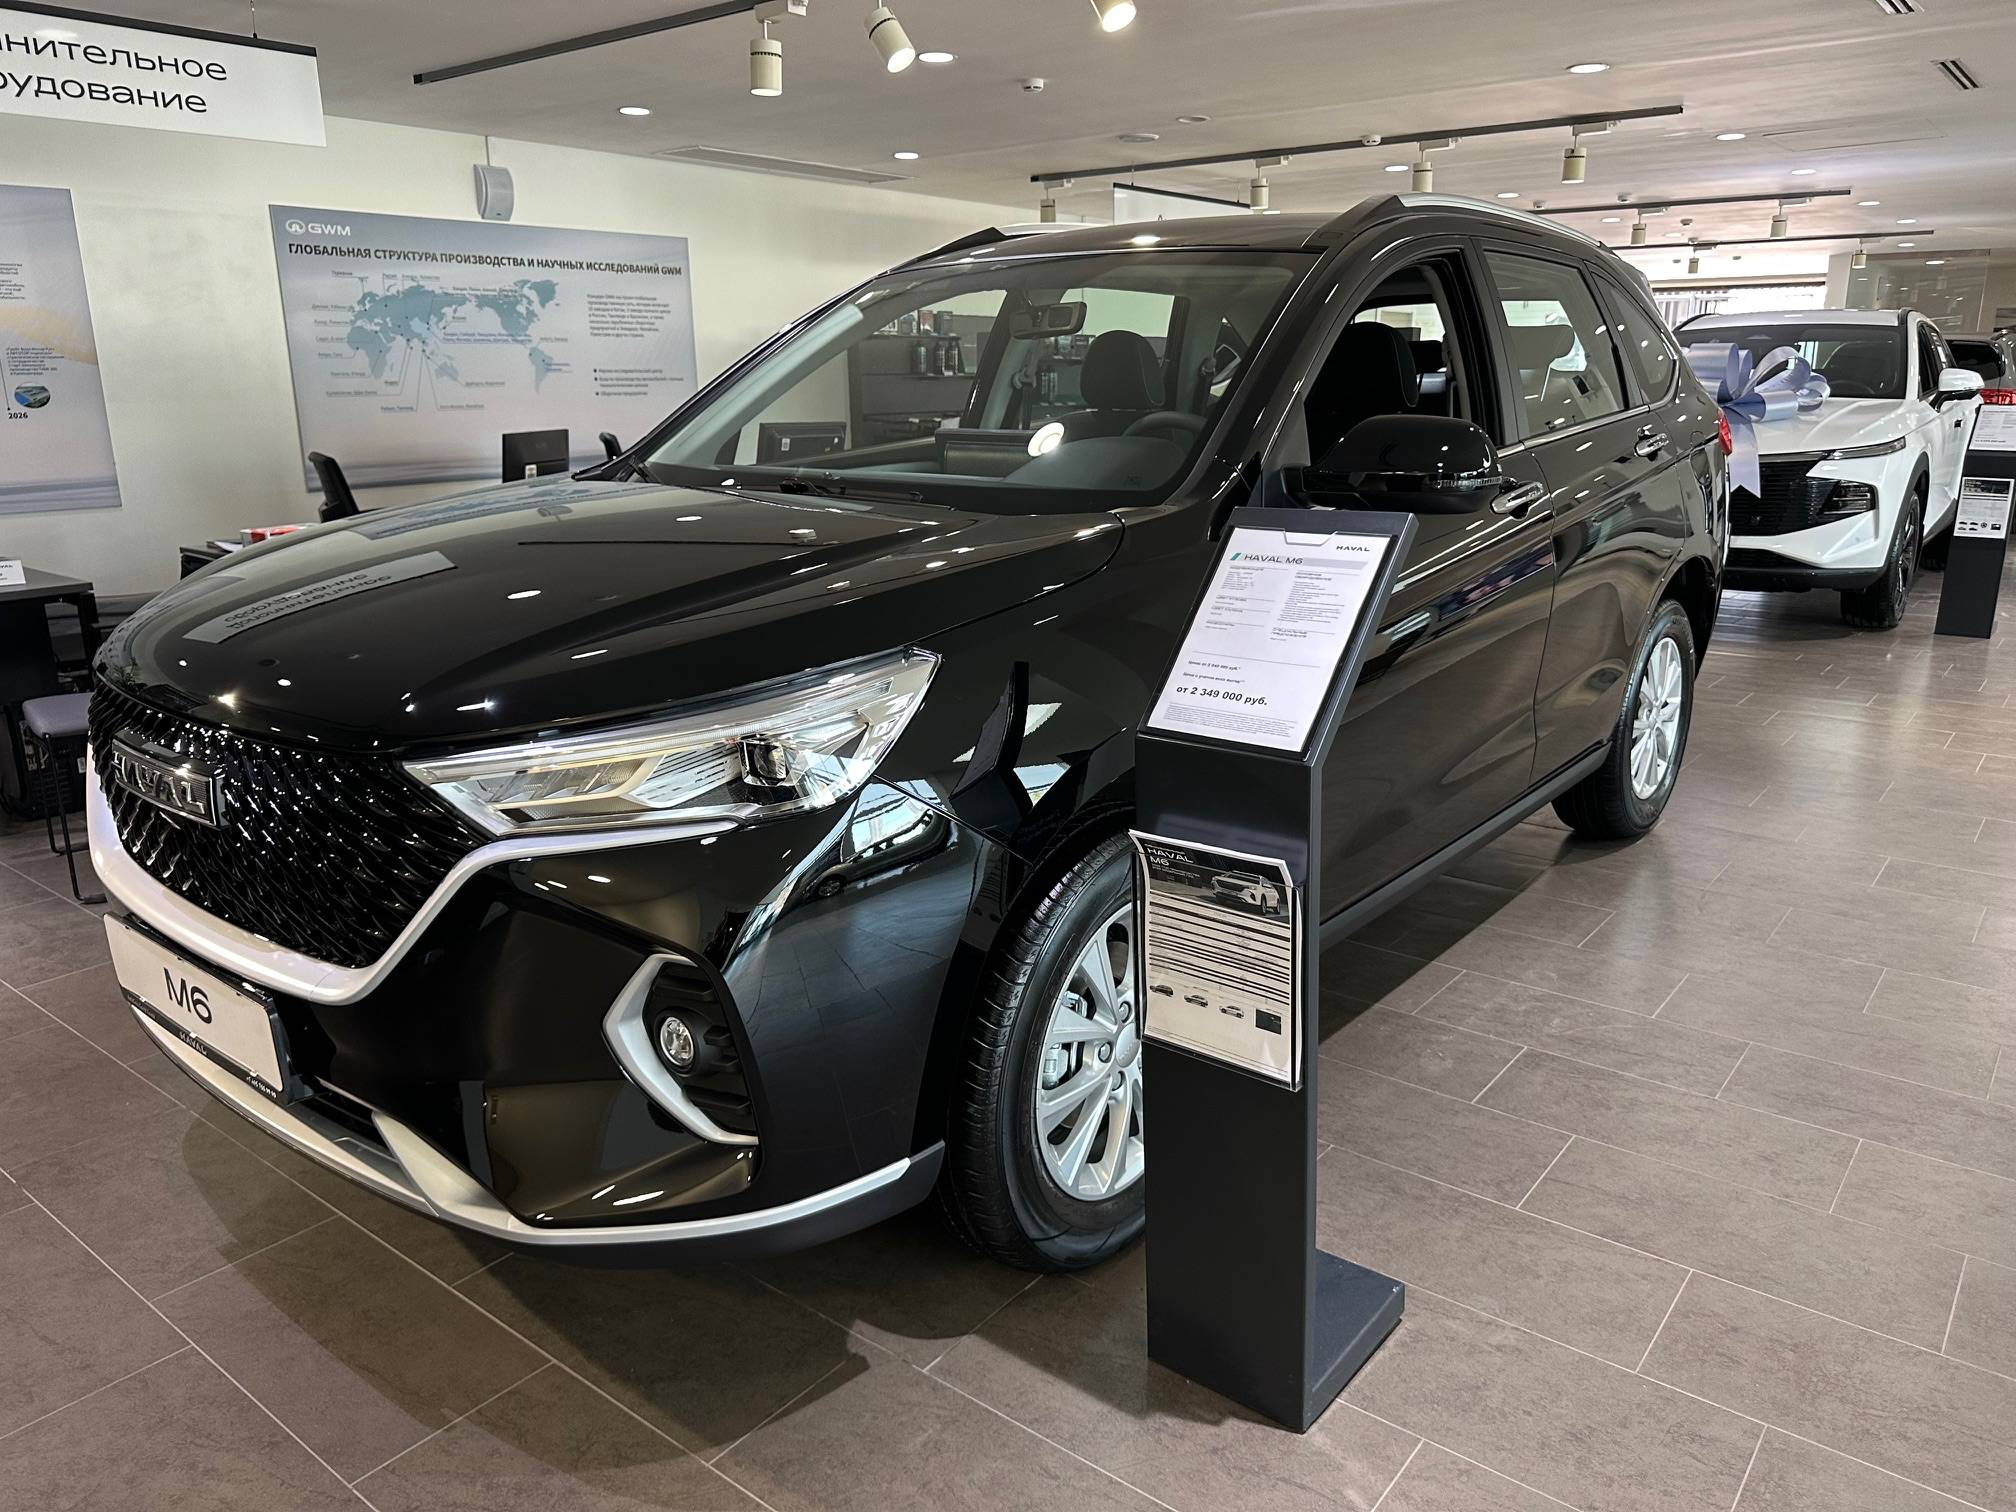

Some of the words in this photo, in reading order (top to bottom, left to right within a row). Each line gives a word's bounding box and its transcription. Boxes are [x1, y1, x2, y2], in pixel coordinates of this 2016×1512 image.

[0, 33, 228, 81] нительное
[308, 223, 351, 236] GWM
[288, 243, 372, 259] ГЛОБАЛЬНАЯ
[374, 248, 439, 263] СТРУКТУРА
[440, 253, 525, 269] ПРОИЗВОДСТВА
[527, 258, 535, 268] И
[536, 259, 585, 272] НАУЧНЫХ
[586, 262, 660, 275] ИССЛЕДОВАНИЙ
[661, 267, 682, 276] GWM
[8, 412, 29, 420] 2026
[1243, 554, 1283, 563] HAVAL
[1285, 557, 1303, 565] M6
[1190, 686, 1198, 695] 2
[1200, 688, 1220, 698] 349
[1222, 691, 1243, 702] 000
[1243, 697, 1268, 706] руб.
[1146, 847, 1194, 864] HAVAL
[1149, 856, 1170, 866] M6
[163, 966, 213, 1025] M6
